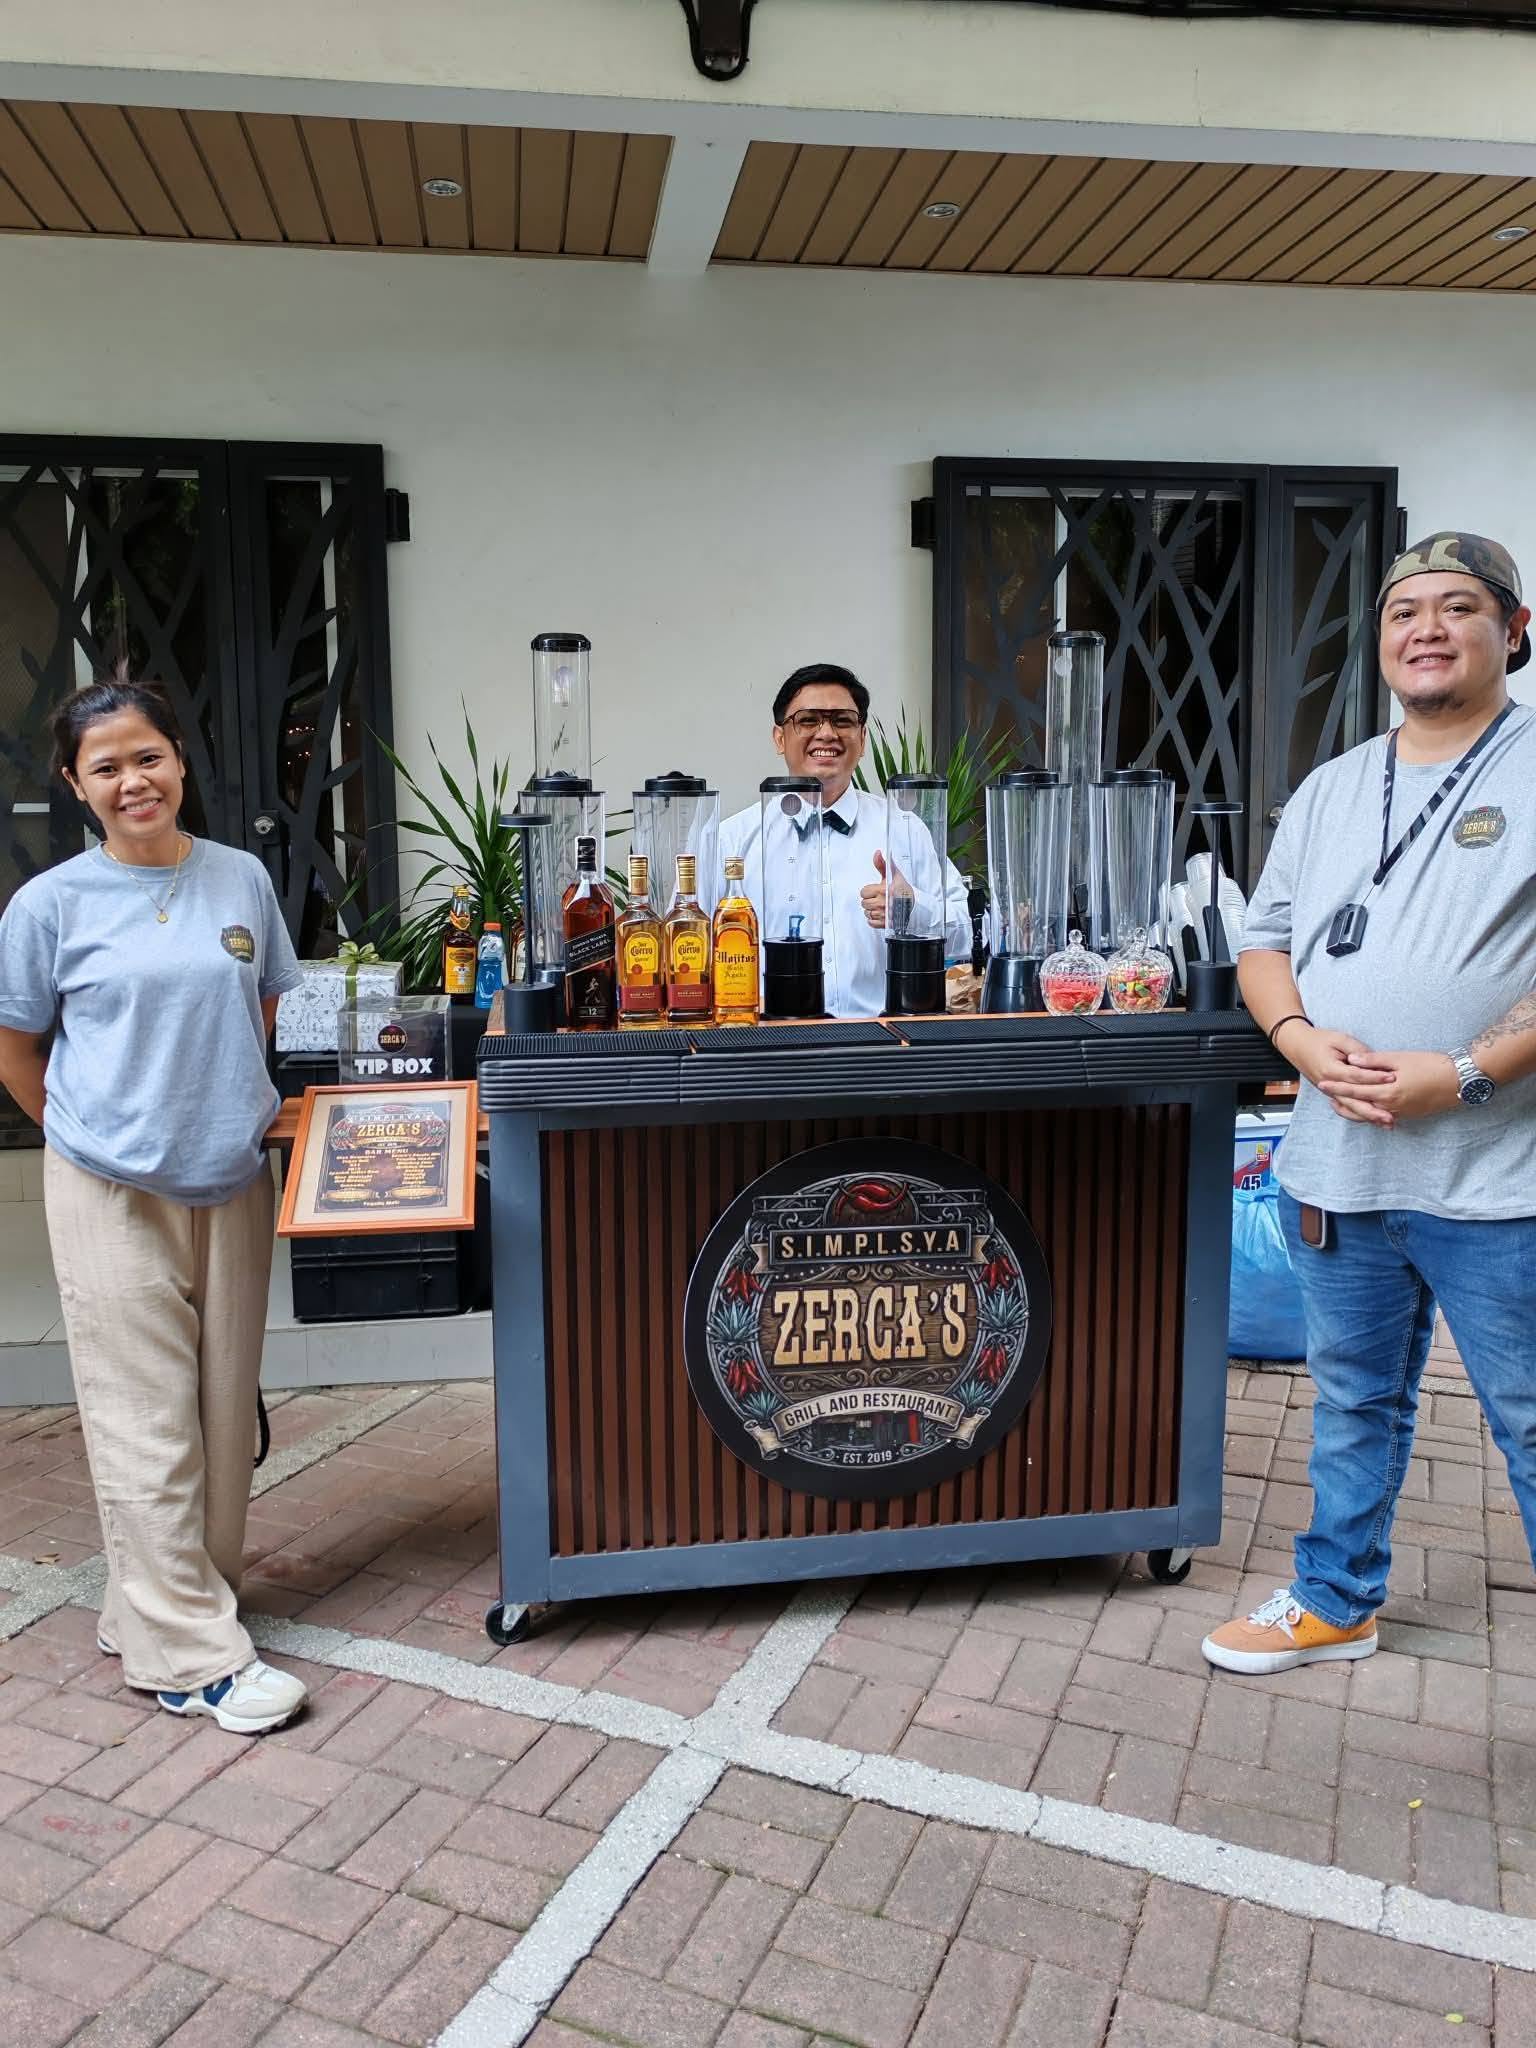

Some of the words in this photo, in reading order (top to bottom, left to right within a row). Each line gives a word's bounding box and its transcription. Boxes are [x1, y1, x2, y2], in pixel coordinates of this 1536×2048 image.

[588, 1007, 598, 1016] 12
[354, 1058, 389, 1075] TIP
[391, 1057, 434, 1075] BOX
[356, 1122, 421, 1137] ZERCA'S
[1240, 1174, 1261, 1190] 45
[780, 1230, 961, 1260] S.I.M.P.L.S.Y.A
[773, 1282, 968, 1366] ZERCA'S
[783, 1404, 827, 1428] GRILL
[829, 1394, 859, 1414] AND
[862, 1391, 955, 1419] RESTAURANT
[842, 1452, 864, 1464] EST.
[867, 1449, 893, 1463] 2019
